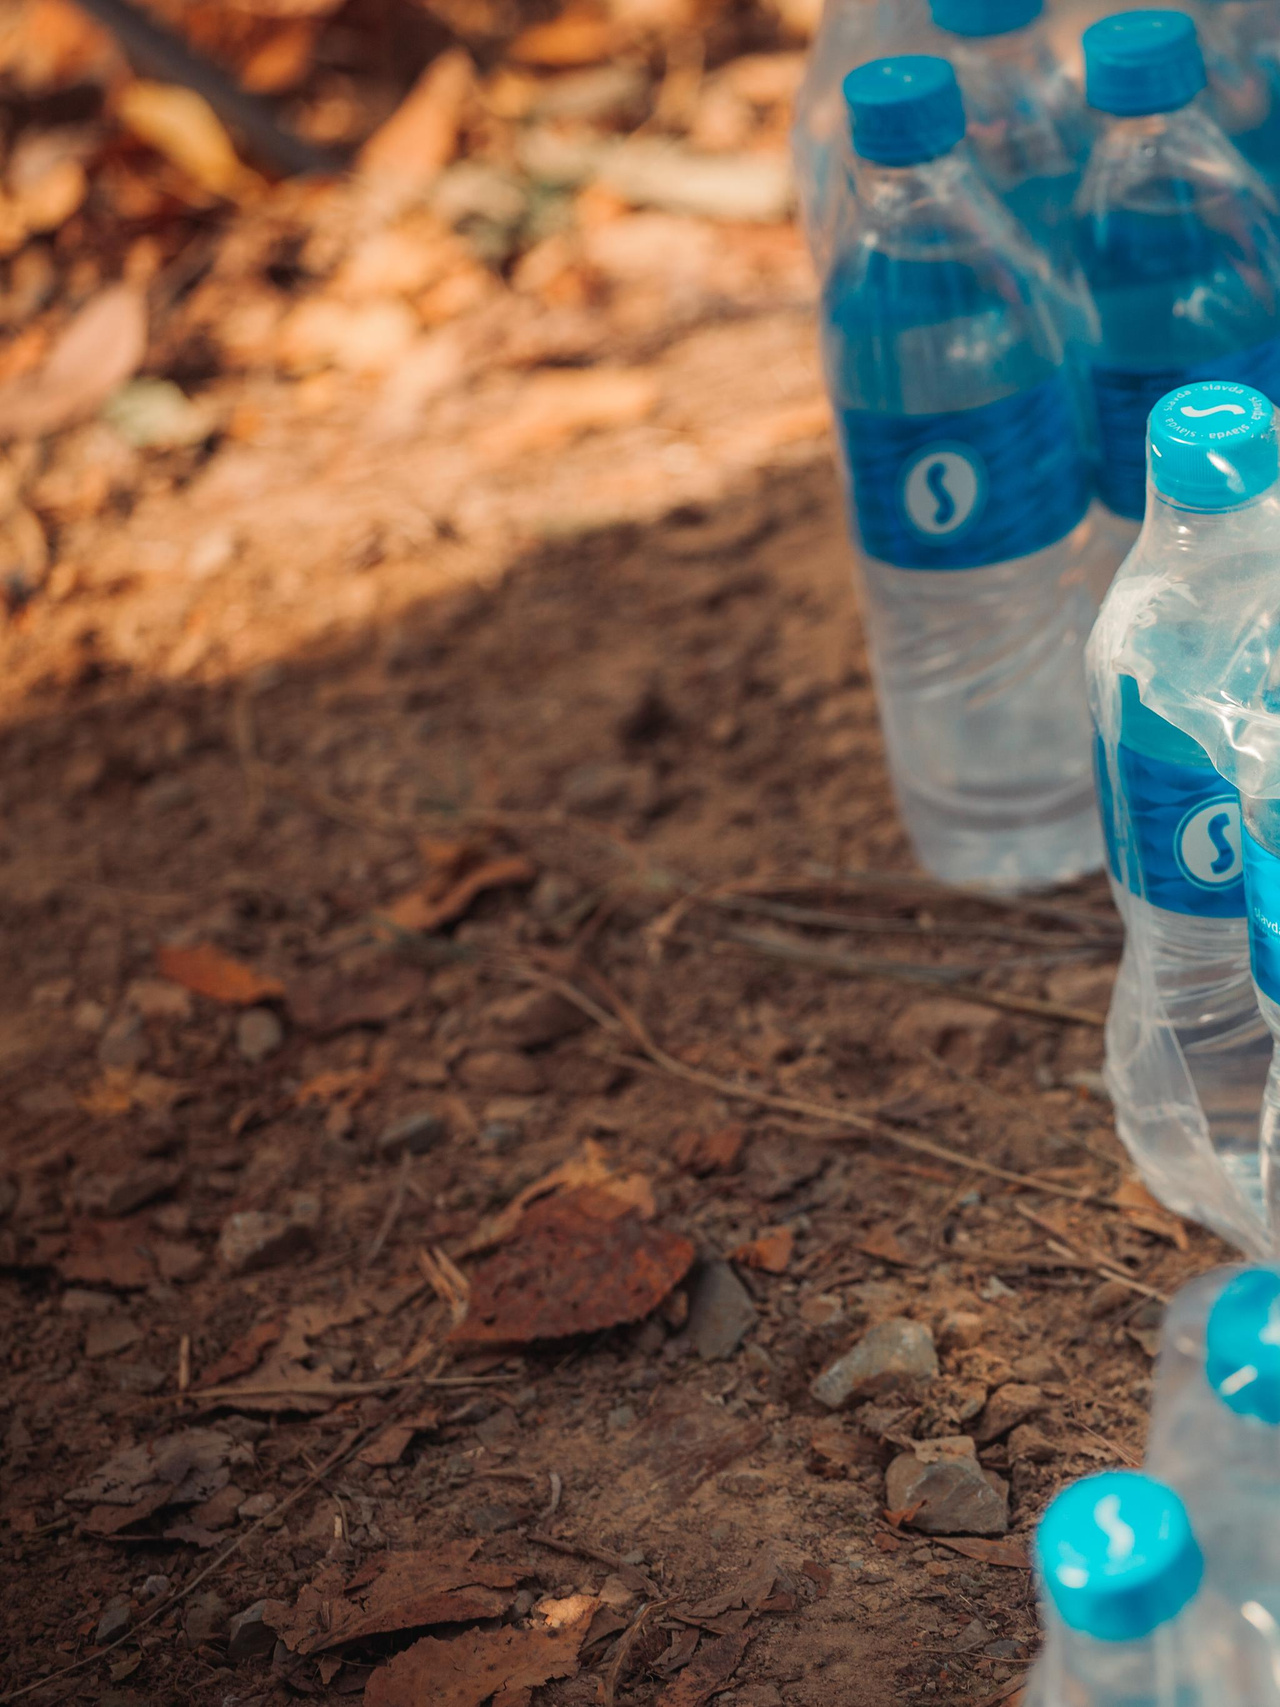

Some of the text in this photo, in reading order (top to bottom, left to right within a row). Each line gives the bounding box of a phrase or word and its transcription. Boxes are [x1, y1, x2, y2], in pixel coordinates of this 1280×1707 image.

[1202, 384, 1244, 395] slavda
[1165, 417, 1197, 437] slavda
[1209, 424, 1250, 440] slavda
